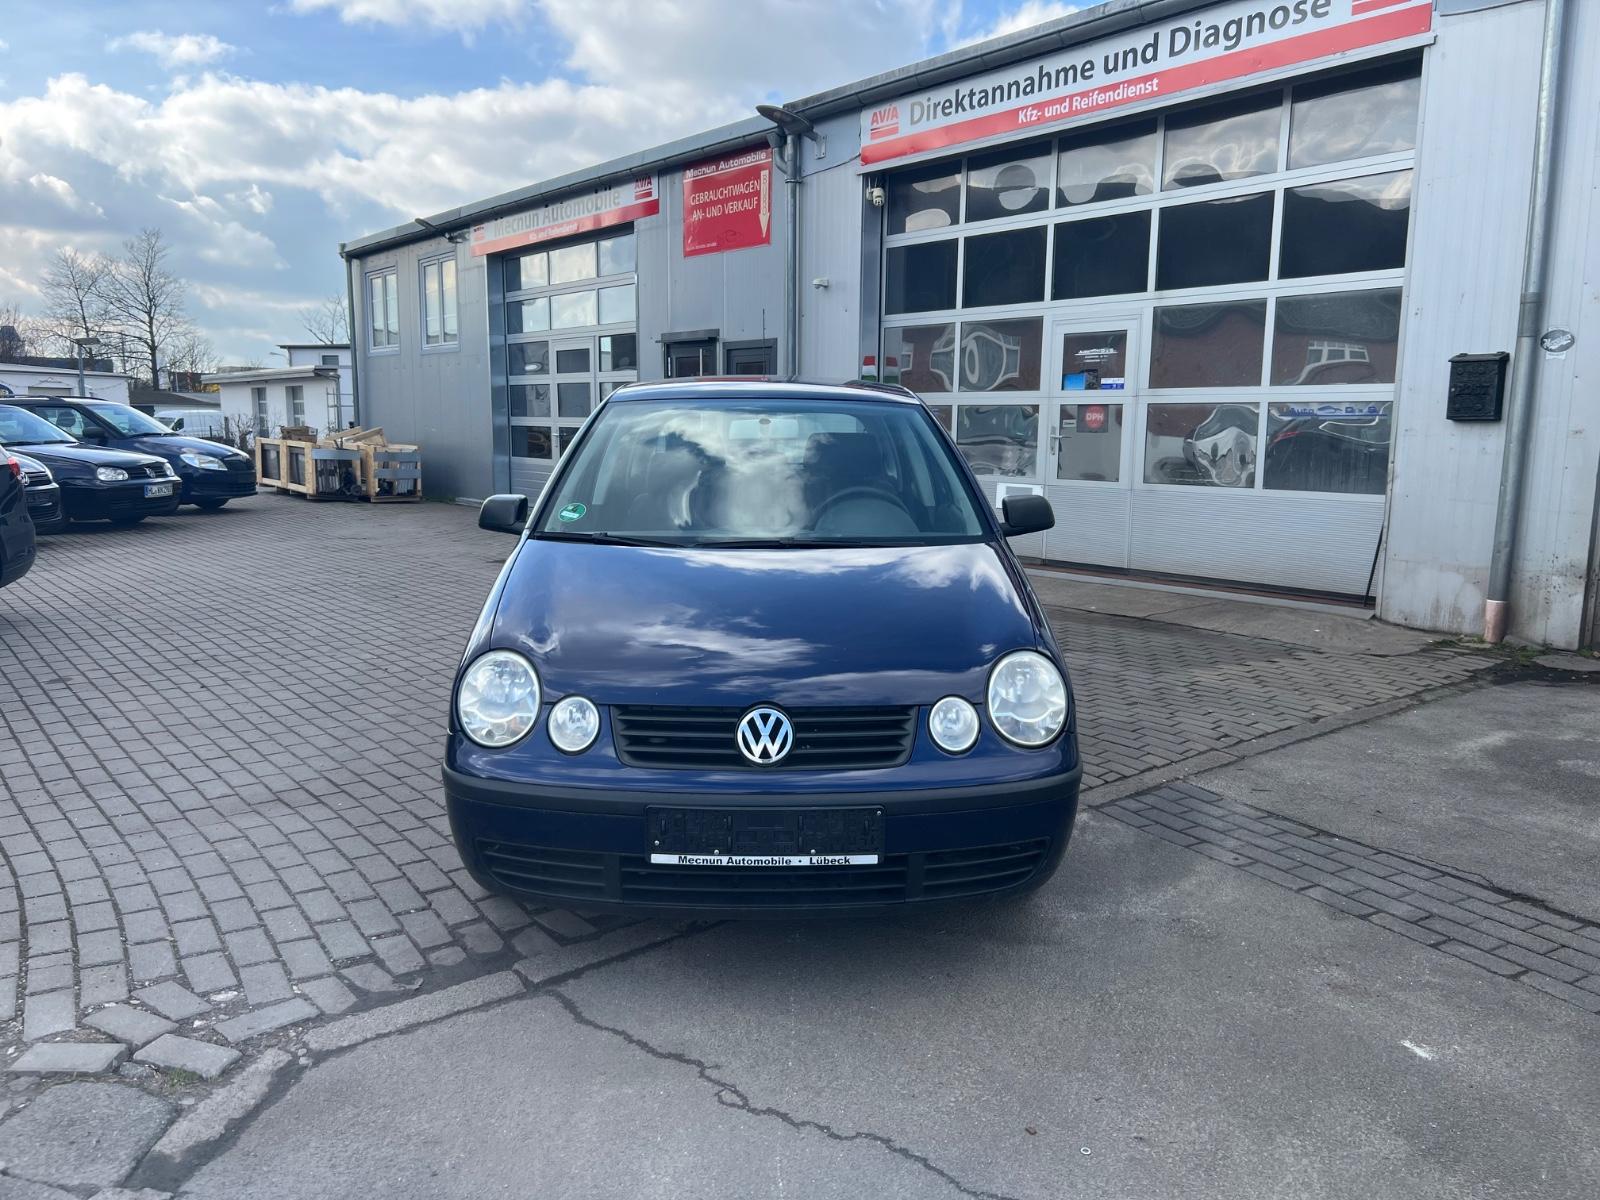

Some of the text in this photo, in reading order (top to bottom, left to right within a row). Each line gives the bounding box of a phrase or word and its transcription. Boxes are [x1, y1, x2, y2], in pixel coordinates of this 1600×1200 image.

[910, 0, 1332, 126] Direktannahme und Diagnose
[1018, 77, 1159, 124] Kfz- und Reifendienst
[871, 105, 898, 126] AVIA
[685, 151, 767, 179] Mecnun Automobile
[690, 179, 760, 206] GEBRAUCHTWAGEN
[494, 211, 540, 238] Mecnun
[542, 188, 621, 226] Automobile
[692, 196, 759, 221] AN- UND VERKAUF
[678, 855, 850, 866] Mecnun Automobile Lübeck
